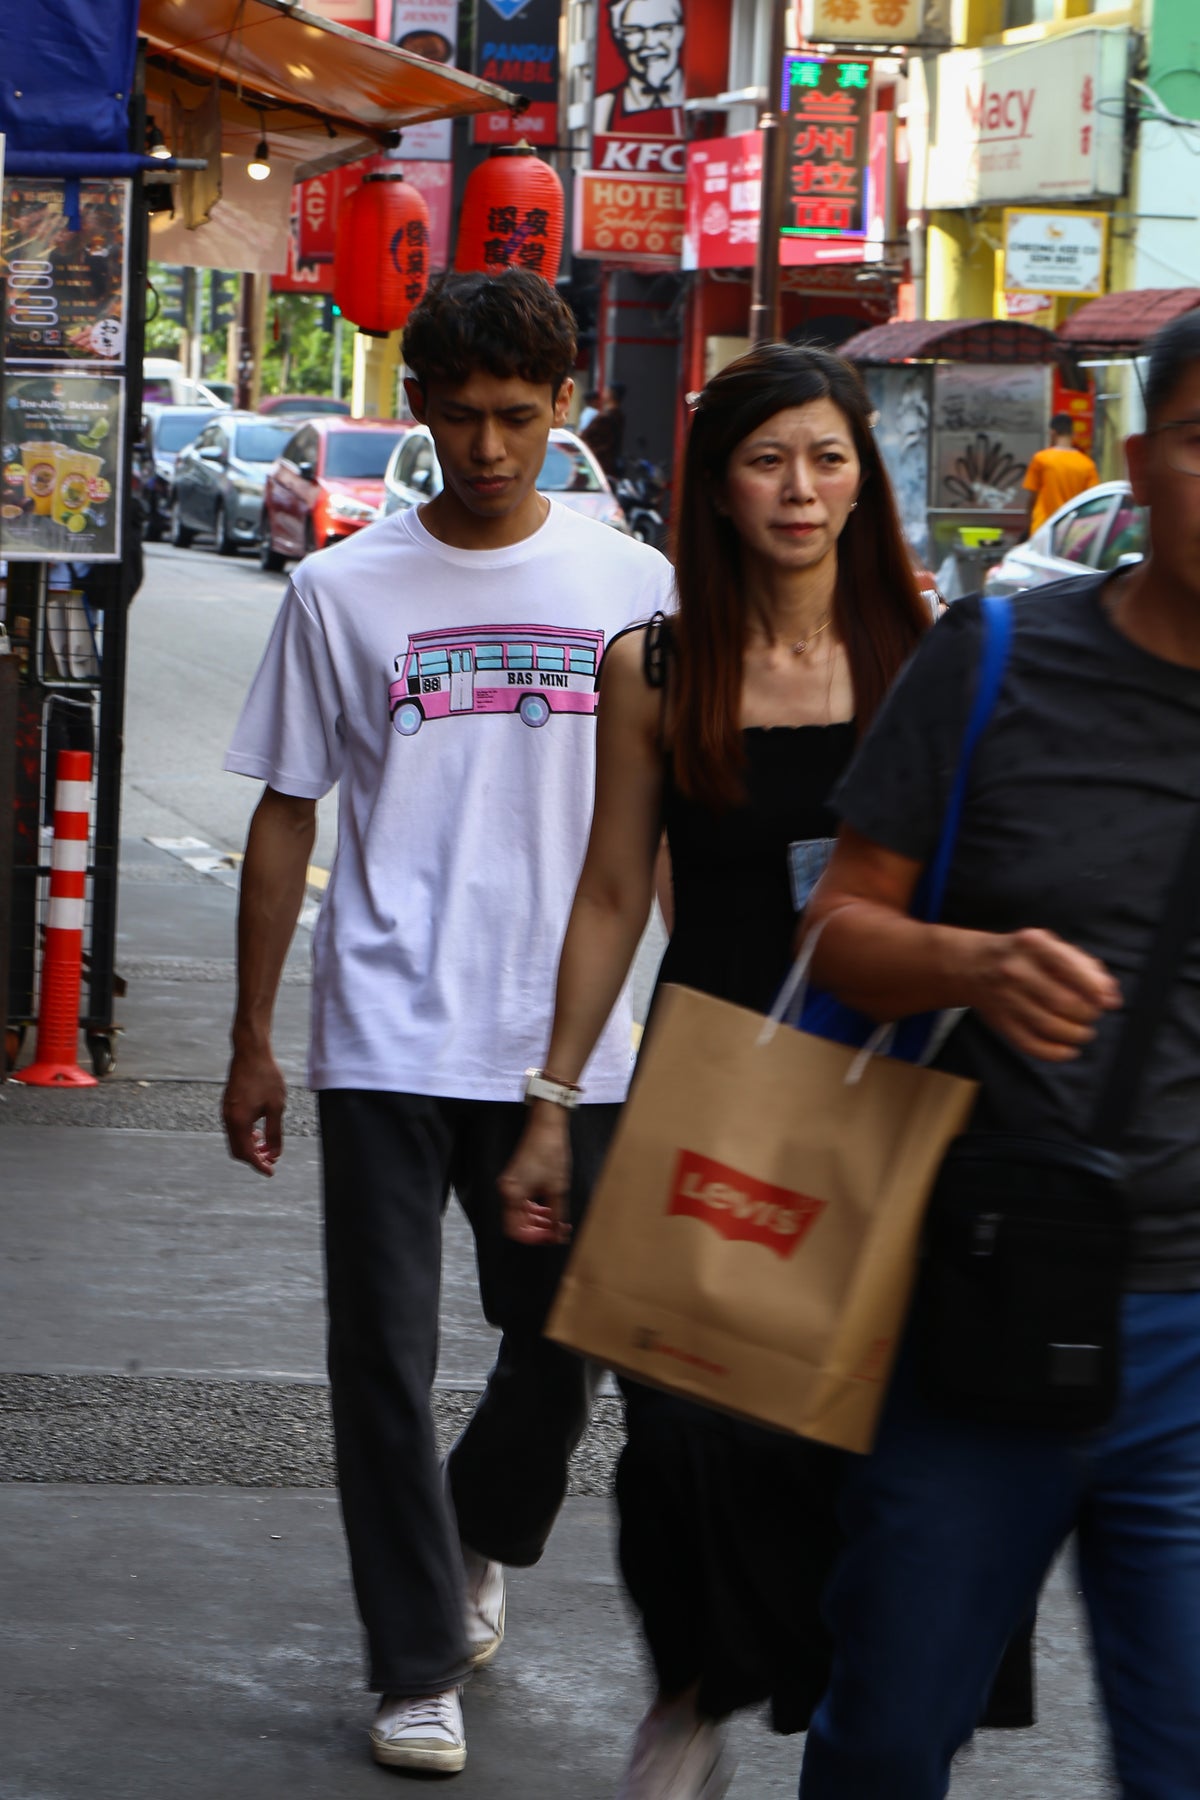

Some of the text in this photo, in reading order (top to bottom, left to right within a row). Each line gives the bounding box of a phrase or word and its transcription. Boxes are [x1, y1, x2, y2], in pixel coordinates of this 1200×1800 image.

[482, 42, 555, 62] PANDU
[482, 61, 554, 83] AMBIL
[490, 115, 545, 131] DI SINI
[601, 141, 685, 172] KFC
[593, 183, 686, 209] HOTEL
[1030, 254, 1051, 262] SDN
[422, 677, 441, 694] 88
[507, 672, 568, 687] BAS MINI
